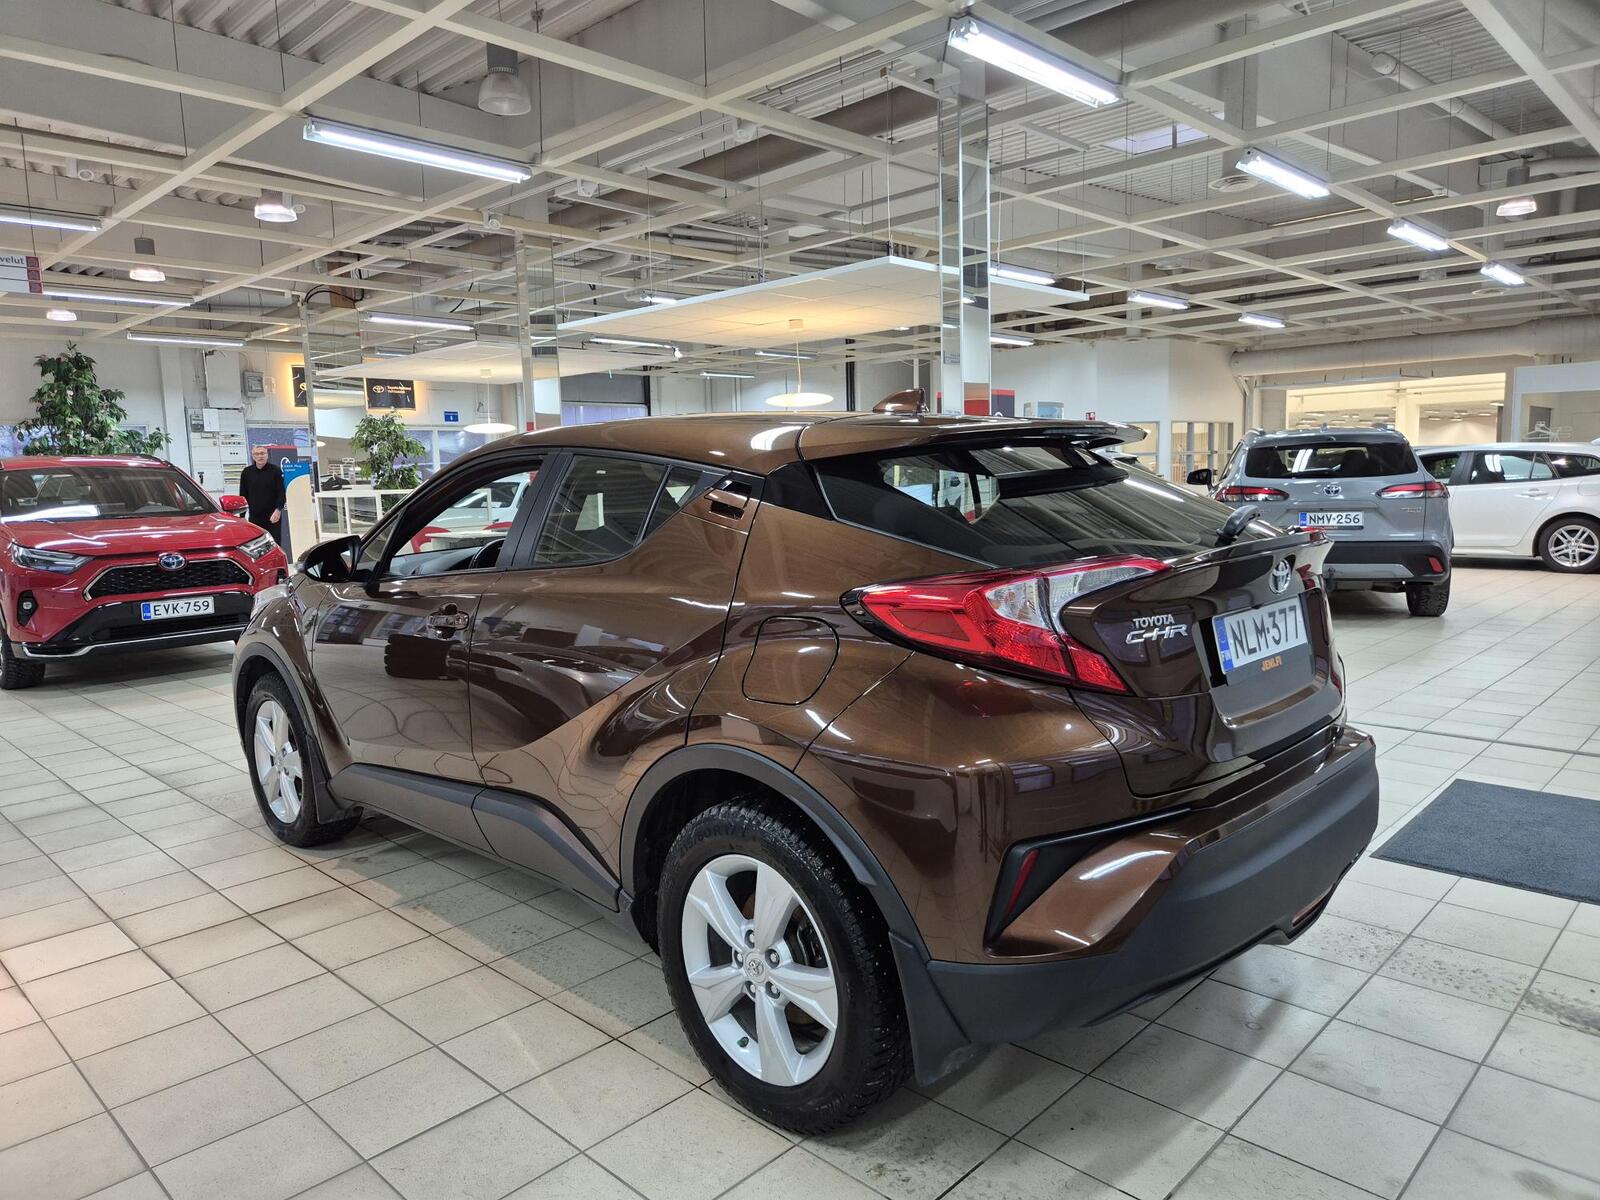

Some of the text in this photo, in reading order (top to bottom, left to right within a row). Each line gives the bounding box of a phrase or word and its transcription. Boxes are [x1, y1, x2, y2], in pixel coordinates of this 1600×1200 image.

[1309, 513, 1360, 524] NMV-256
[153, 600, 210, 616] EVK-759
[1133, 614, 1175, 629] TOYOTA
[1126, 624, 1188, 645] C-HR
[1230, 604, 1299, 660] NLM-377
